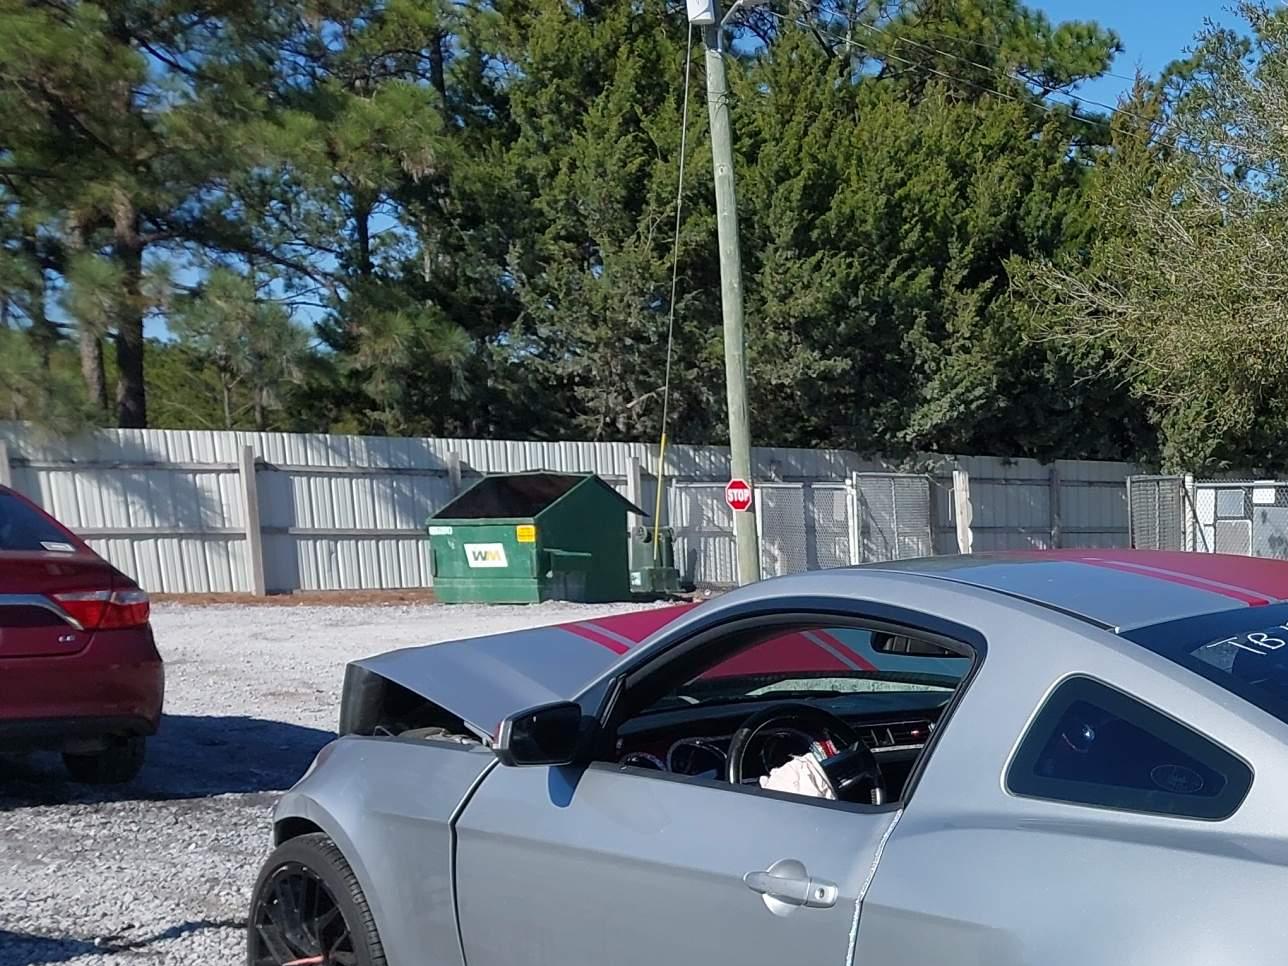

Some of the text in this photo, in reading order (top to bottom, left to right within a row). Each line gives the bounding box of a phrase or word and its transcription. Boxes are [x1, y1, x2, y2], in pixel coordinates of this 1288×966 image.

[728, 489, 750, 502] STOP
[472, 550, 502, 562] WM
[1206, 632, 1286, 655] TB
